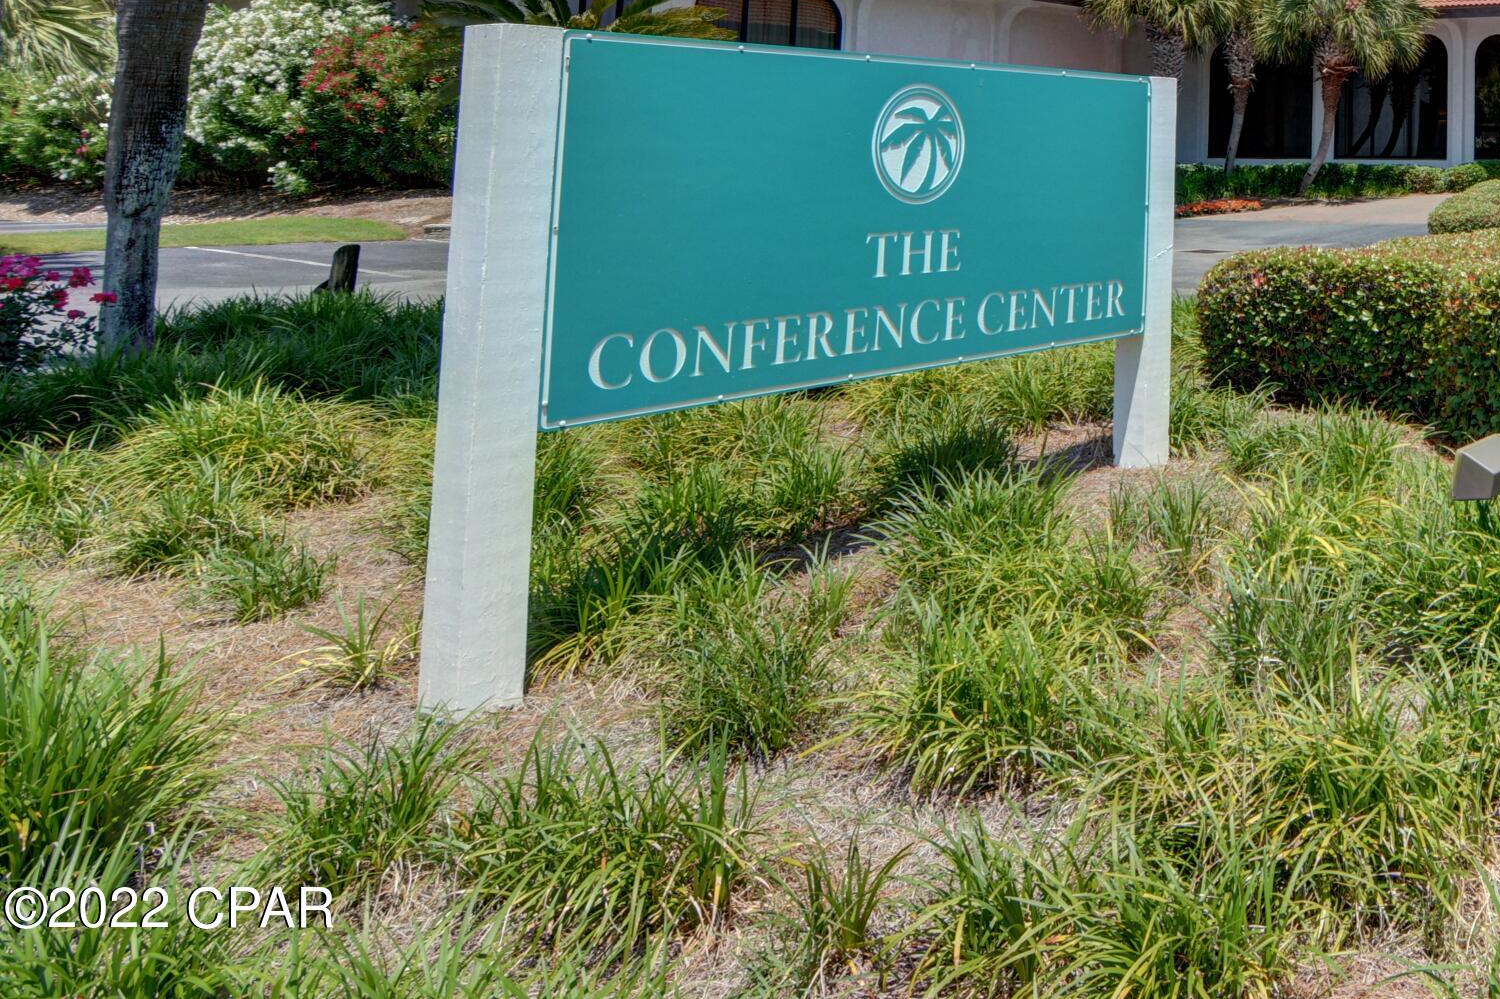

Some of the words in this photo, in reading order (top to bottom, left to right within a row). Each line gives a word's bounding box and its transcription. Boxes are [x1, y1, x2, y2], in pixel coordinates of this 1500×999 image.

[865, 228, 962, 279] THE
[587, 296, 967, 390] CONFERENCE
[976, 279, 1126, 336] CENTER
